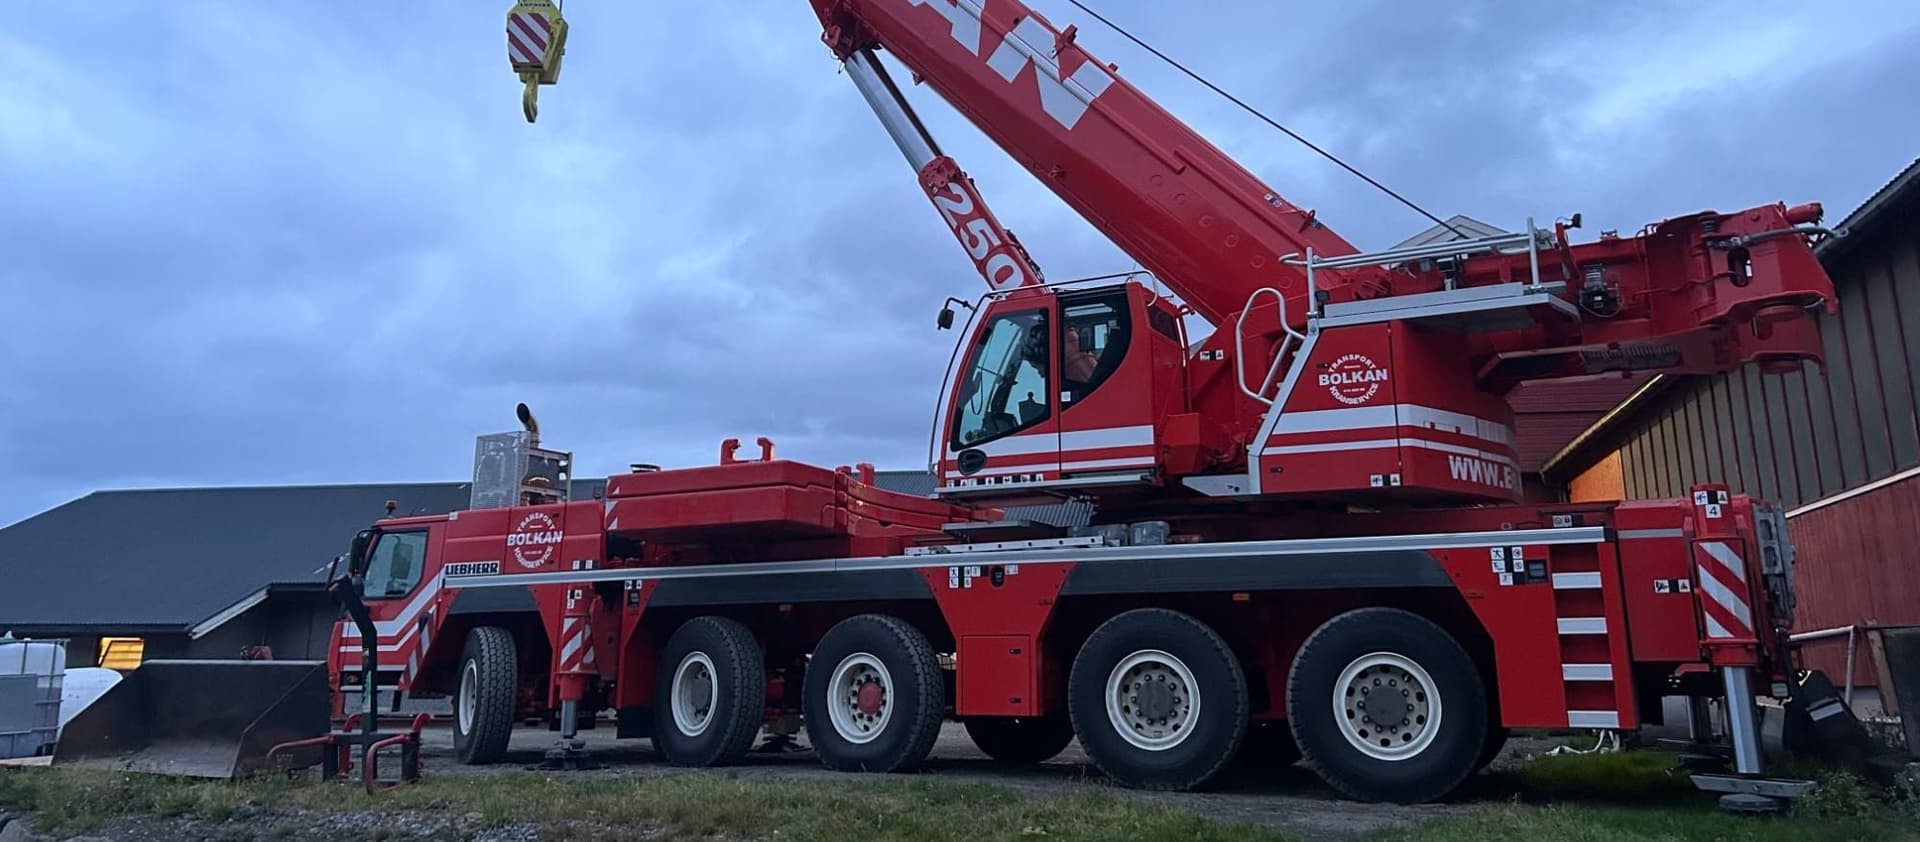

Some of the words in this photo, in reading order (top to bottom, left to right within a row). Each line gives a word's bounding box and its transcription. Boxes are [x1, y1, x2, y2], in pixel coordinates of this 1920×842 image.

[933, 182, 1024, 291] 250
[1328, 354, 1376, 373] TRANSPORT
[1319, 368, 1388, 386] BOLKAN
[507, 531, 563, 546] BOLKAN
[445, 562, 498, 575] LIEBHERR
